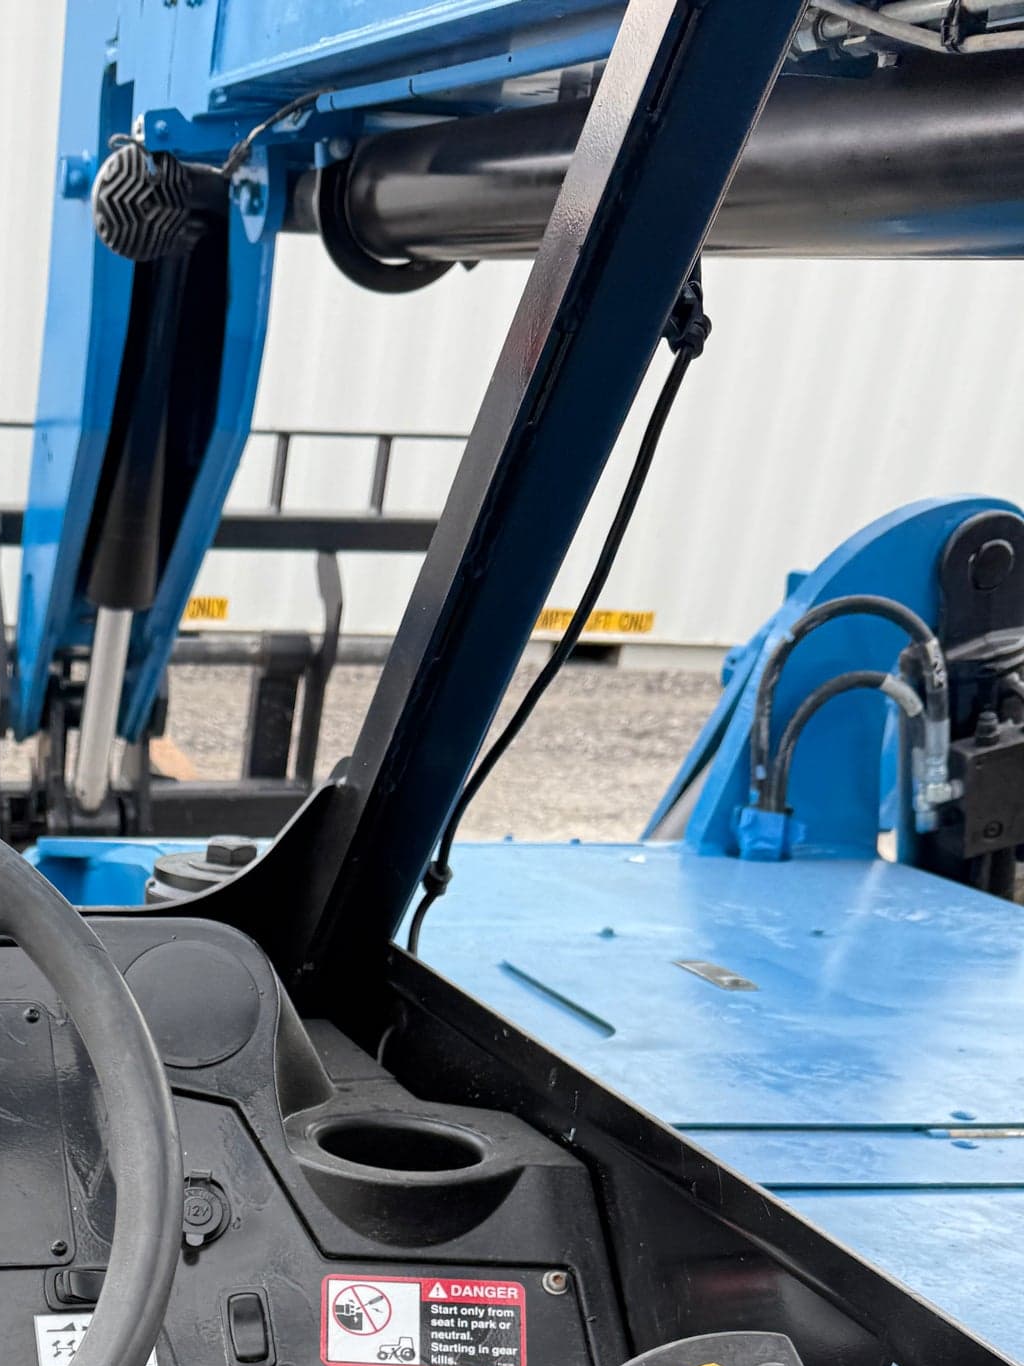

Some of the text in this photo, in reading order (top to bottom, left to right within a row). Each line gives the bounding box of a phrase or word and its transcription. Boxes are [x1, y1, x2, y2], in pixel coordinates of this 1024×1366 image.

[187, 1205, 209, 1217] 12V
[450, 1284, 518, 1299] DANGER
[431, 1304, 515, 1318] Start only from
[431, 1318, 512, 1330] seat in park or
[431, 1331, 473, 1341] neutral.
[431, 1342, 518, 1357] Starting in gear
[431, 1355, 457, 1365] kills.
